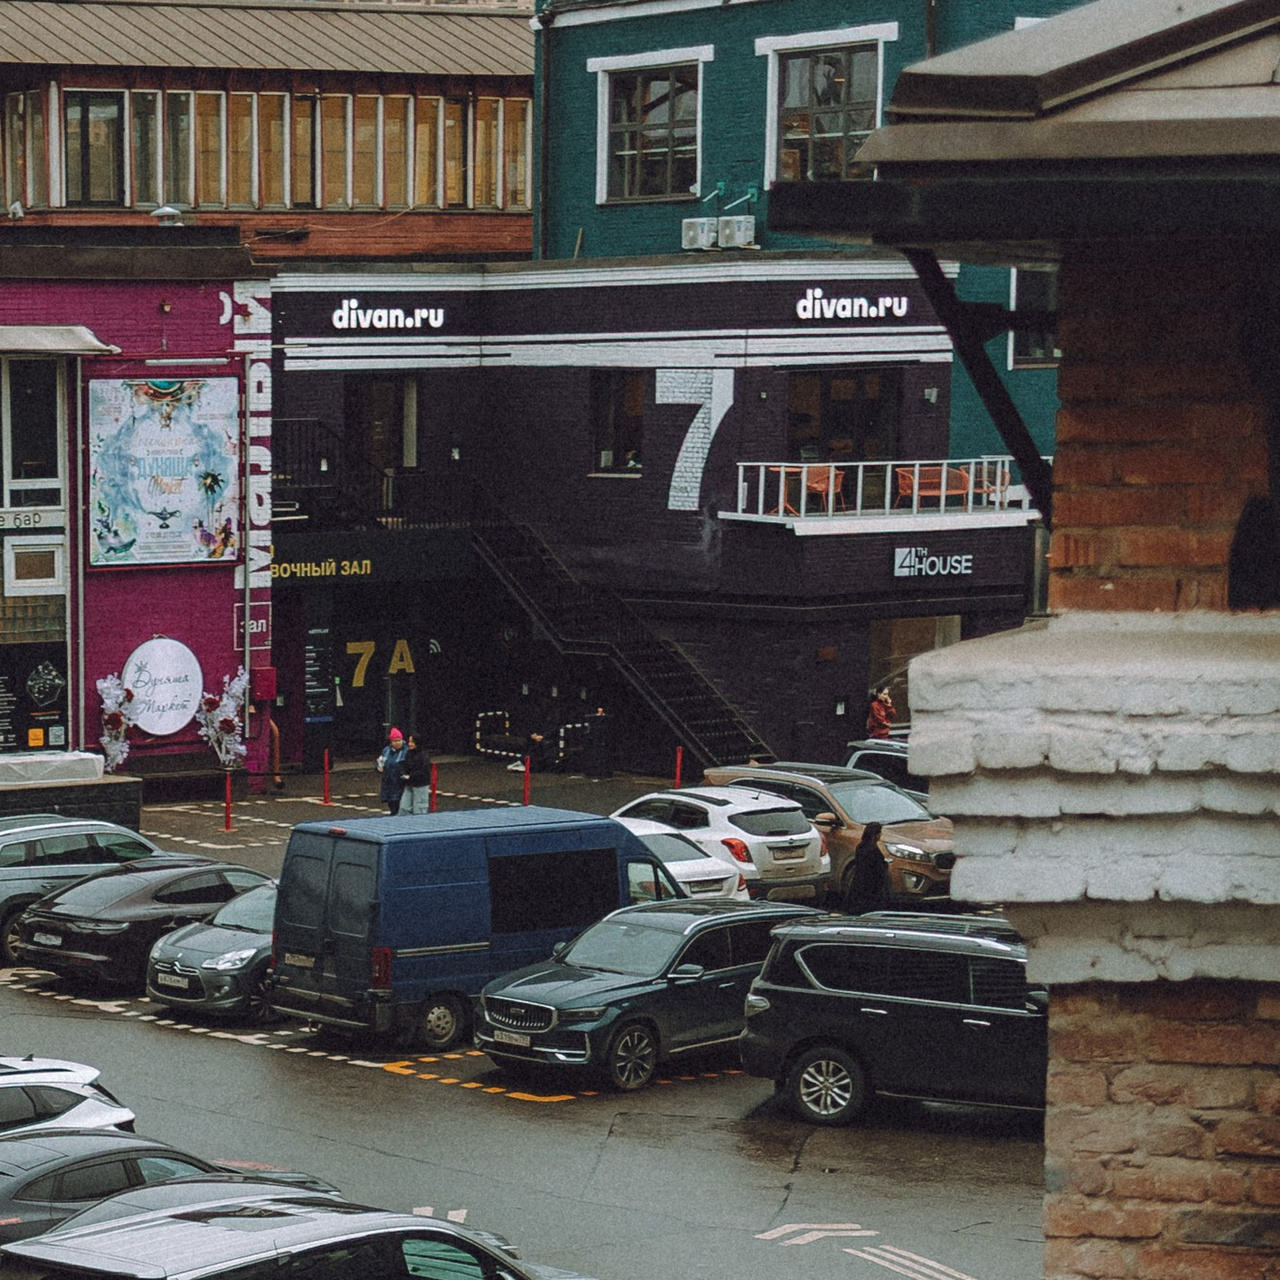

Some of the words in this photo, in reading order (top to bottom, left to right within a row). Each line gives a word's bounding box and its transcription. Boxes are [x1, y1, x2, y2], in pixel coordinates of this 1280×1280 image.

[332, 298, 445, 329] divan.ru
[796, 287, 908, 319] divan.ru
[655, 368, 734, 510] 7
[14, 513, 41, 528] бар
[341, 560, 371, 575] ЗАЛ
[915, 555, 973, 576] HOUSE
